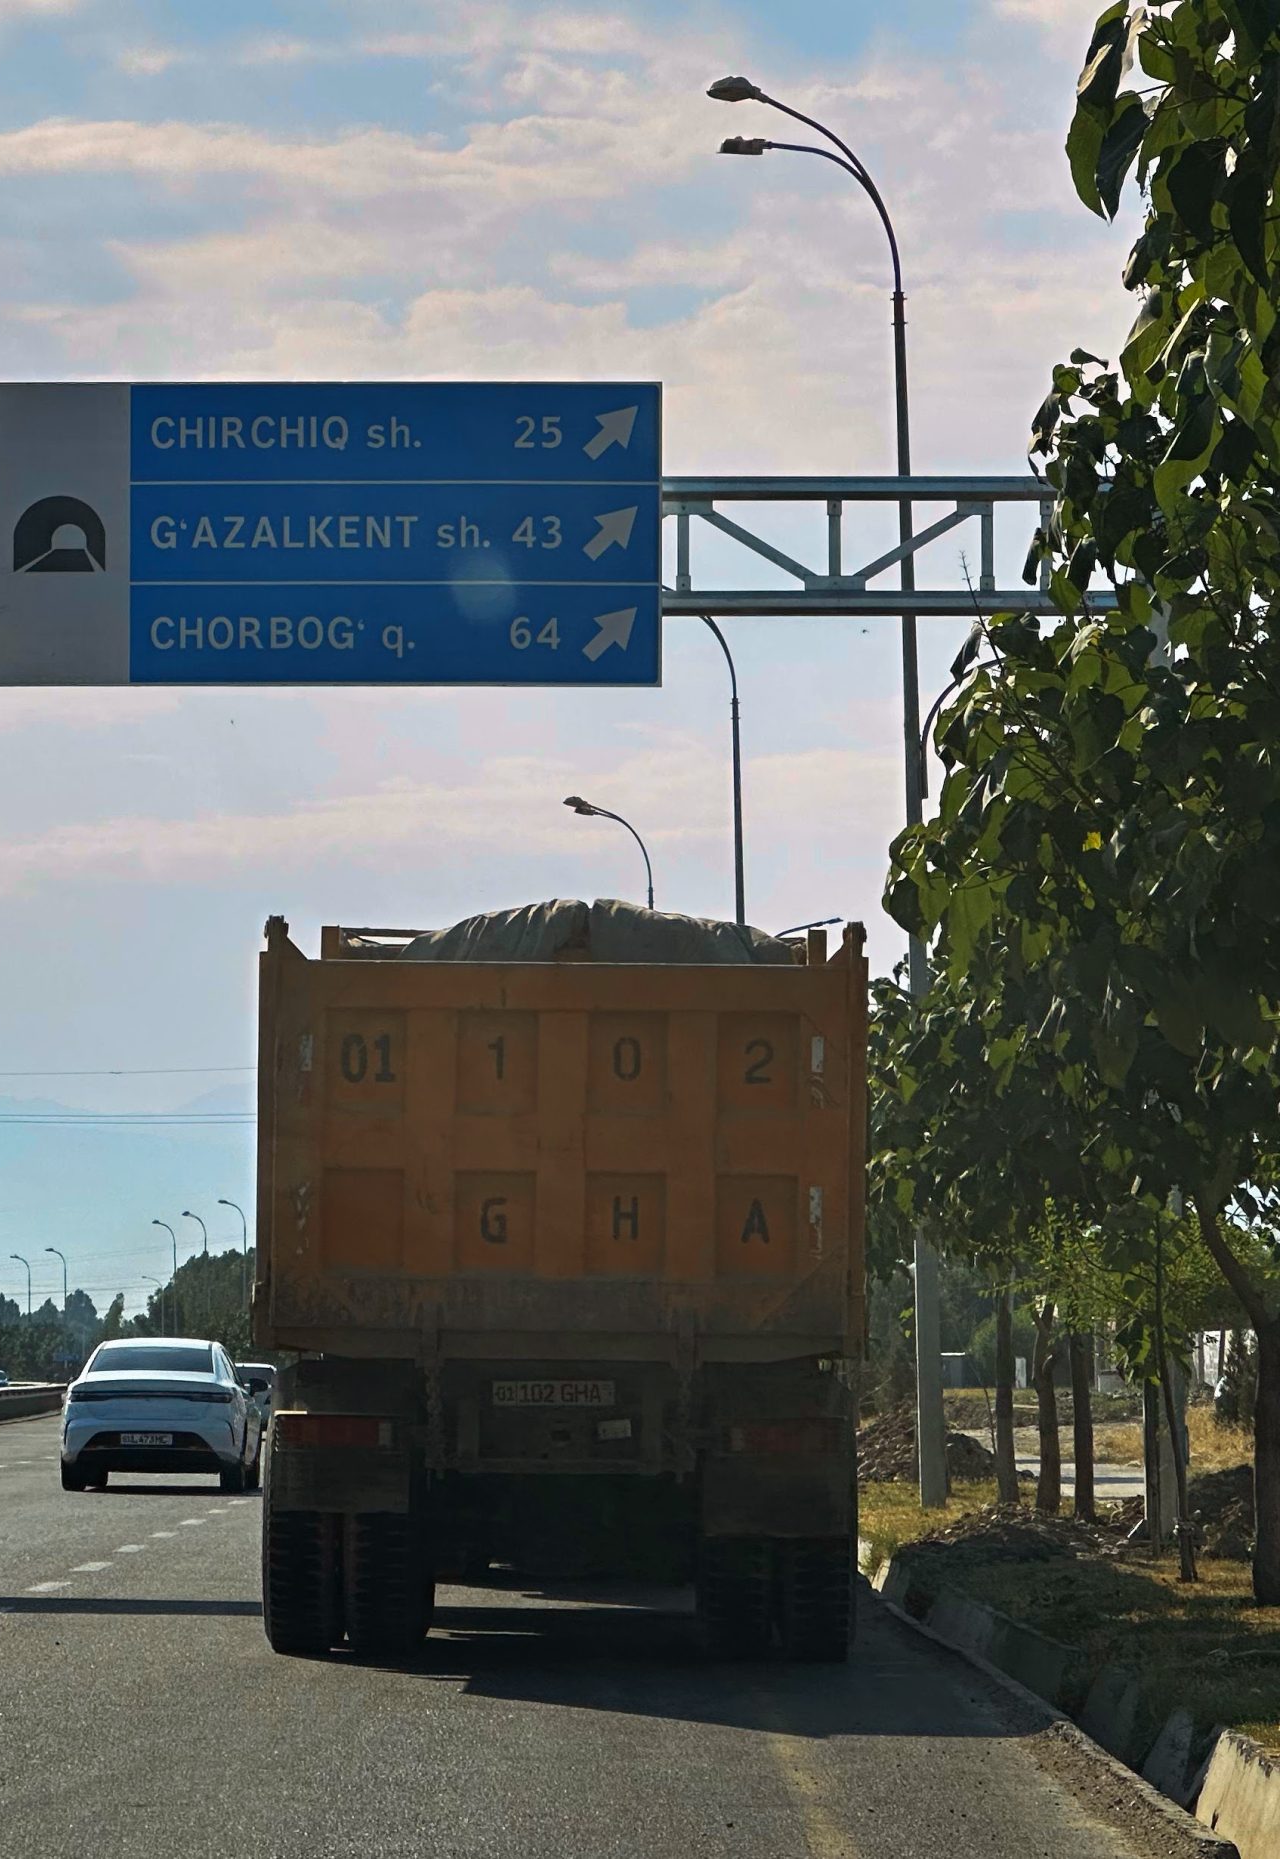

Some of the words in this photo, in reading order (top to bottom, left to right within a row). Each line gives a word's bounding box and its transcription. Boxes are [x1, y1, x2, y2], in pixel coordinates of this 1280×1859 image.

[150, 415, 350, 451] CHIRCHIQ
[366, 416, 422, 449] sh.
[513, 415, 563, 449] 25
[436, 515, 491, 549] sh.
[511, 514, 563, 549] 43
[381, 624, 416, 659] q.
[509, 615, 561, 650] 64
[340, 1033, 396, 1083] 01
[486, 1034, 505, 1081] 1
[744, 1038, 775, 1085] 2
[480, 1196, 508, 1244] G
[612, 1195, 639, 1242] H
[740, 1197, 771, 1244] A
[521, 1384, 555, 1403] 102
[560, 1384, 601, 1403] GHA
